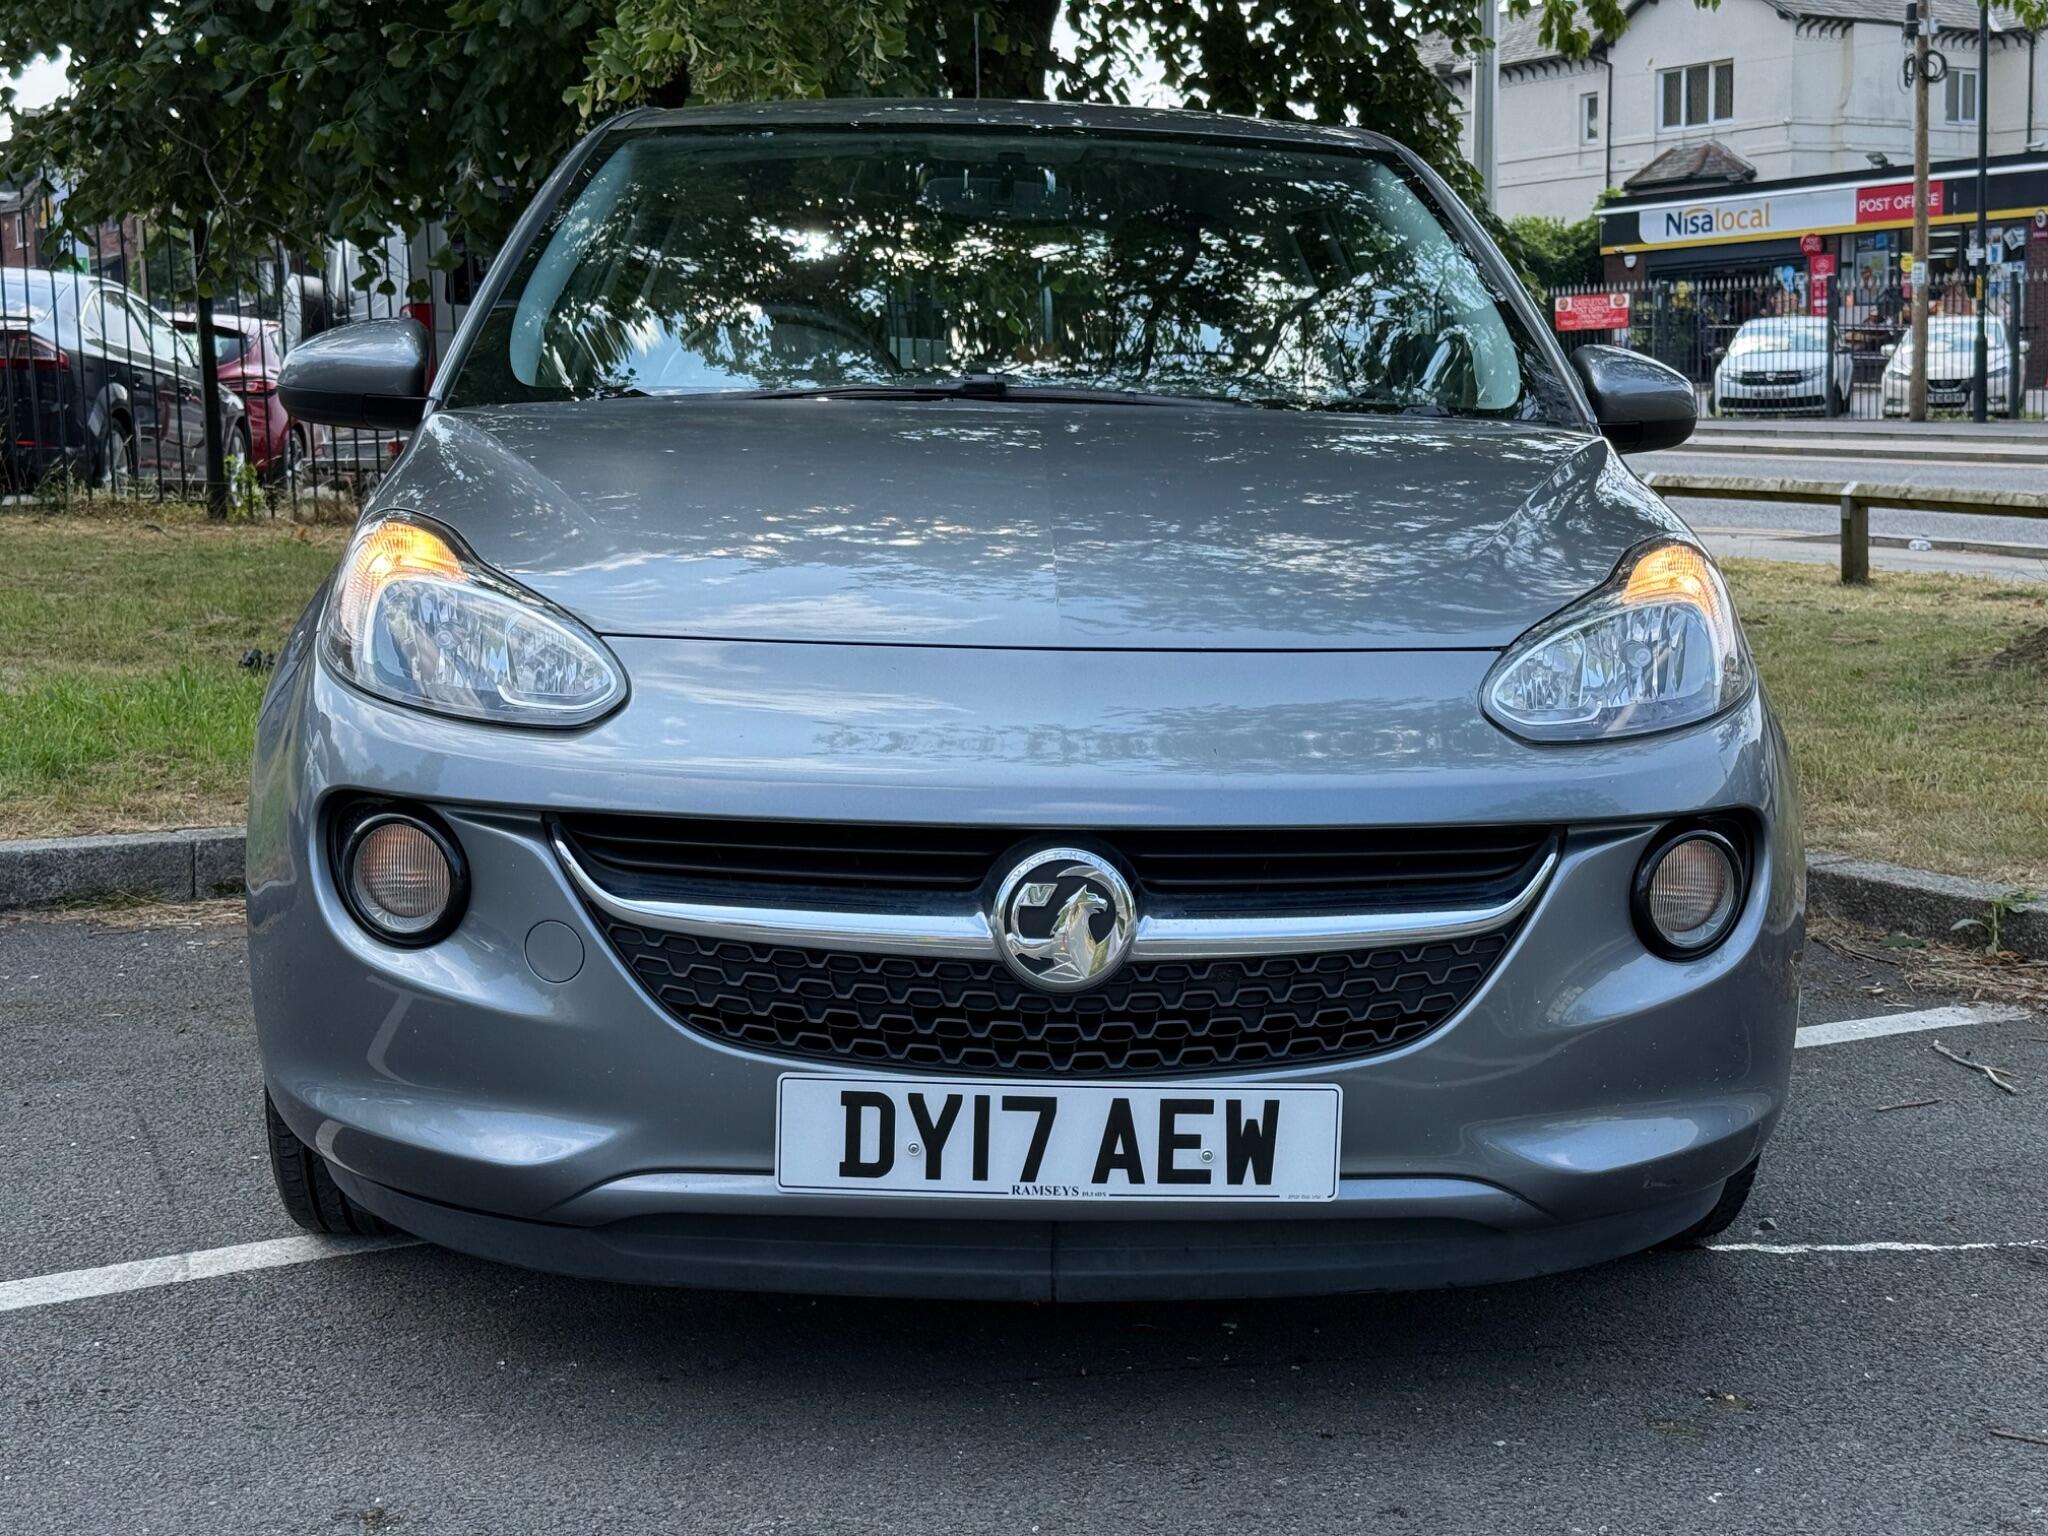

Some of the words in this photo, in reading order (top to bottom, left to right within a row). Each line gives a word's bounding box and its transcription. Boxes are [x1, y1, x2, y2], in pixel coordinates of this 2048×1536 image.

[1859, 197, 1891, 213] POST
[1893, 192, 1939, 210] OFE
[839, 1090, 1057, 1182] DY17
[1091, 1097, 1280, 1186] AEW
[1012, 1184, 1080, 1198] RAMSEYS
